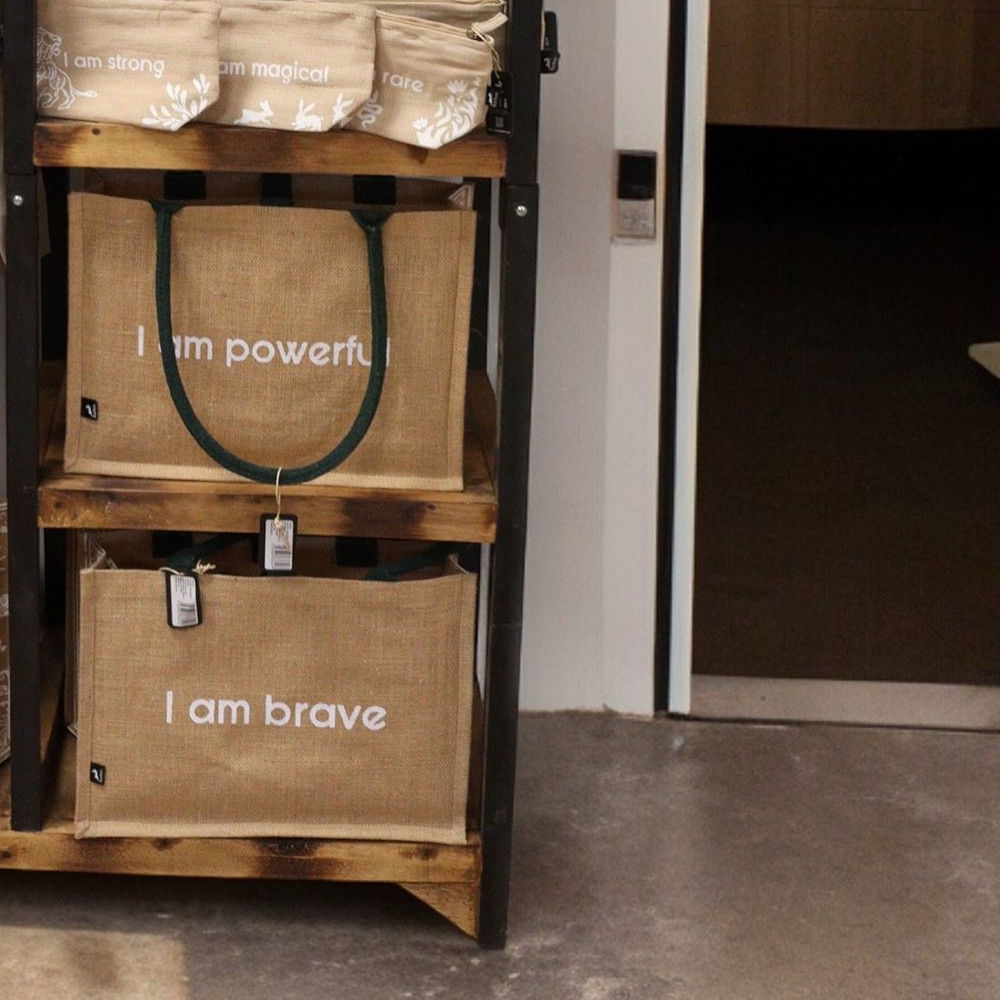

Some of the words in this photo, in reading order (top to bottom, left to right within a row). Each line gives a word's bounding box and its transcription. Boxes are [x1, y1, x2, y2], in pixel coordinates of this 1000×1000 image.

[63, 51, 69, 68] I
[74, 55, 102, 69] am
[107, 54, 165, 79] strong
[219, 60, 246, 76] am
[251, 60, 330, 85] magical
[382, 70, 425, 93] rare
[137, 325, 145, 357] I
[166, 690, 173, 724] I
[189, 698, 250, 725] am
[264, 693, 387, 731] brave
